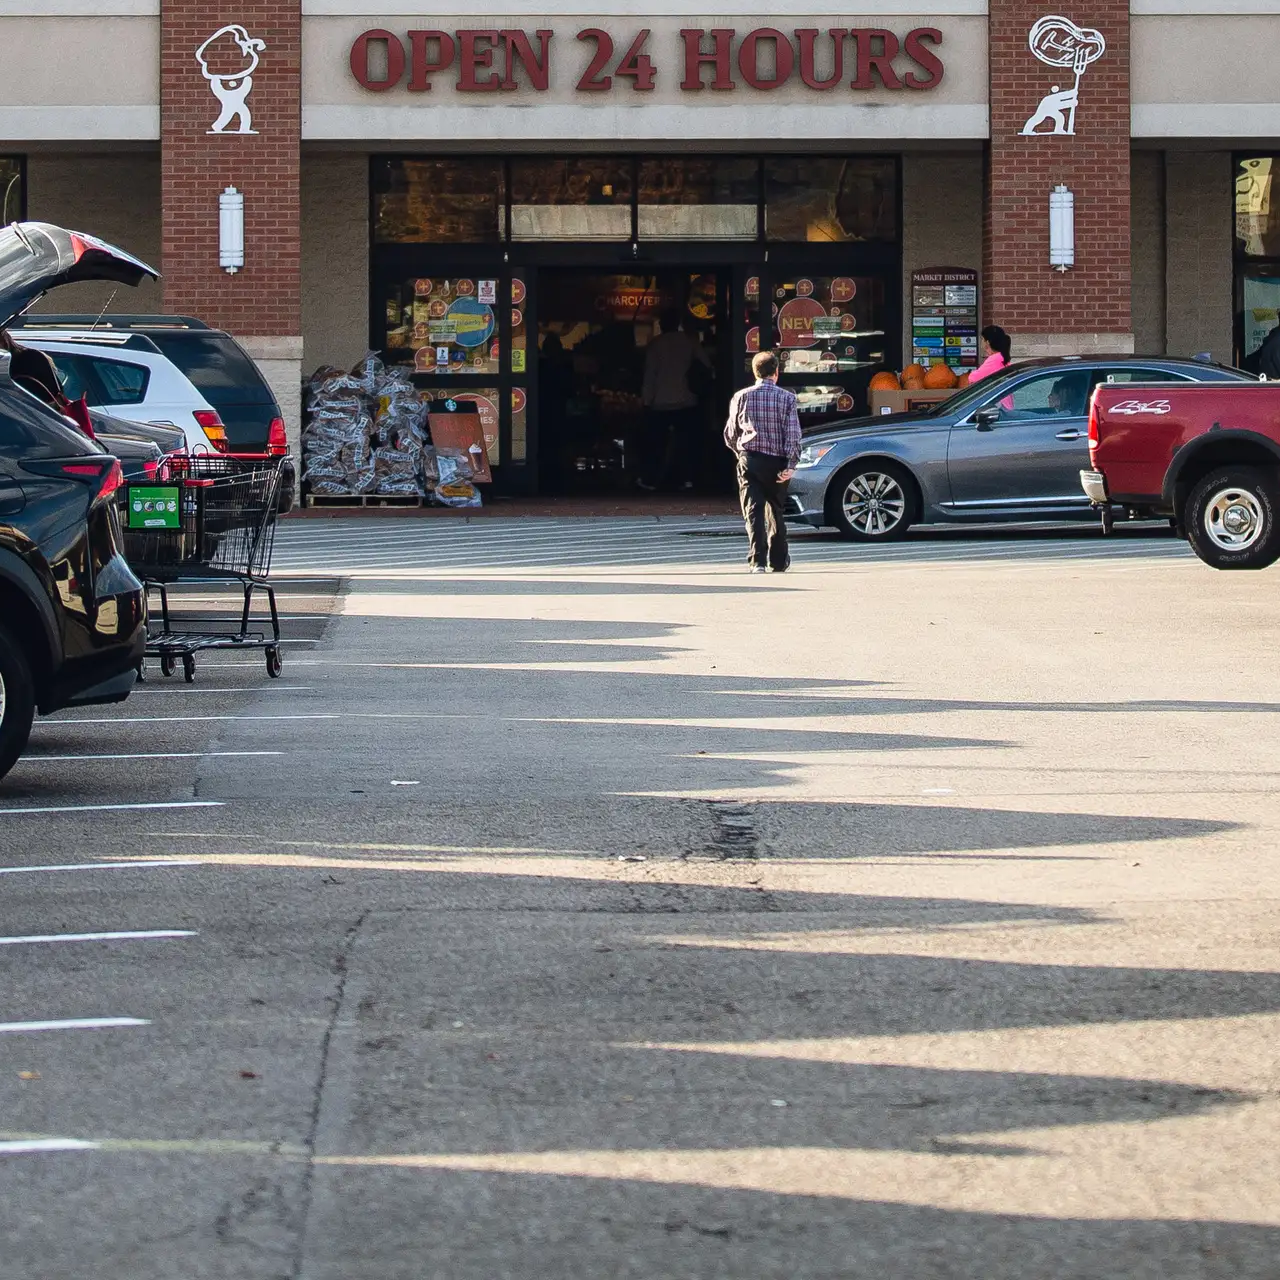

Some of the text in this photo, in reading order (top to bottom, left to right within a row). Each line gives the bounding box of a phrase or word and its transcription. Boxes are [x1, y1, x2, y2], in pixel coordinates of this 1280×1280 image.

[349, 26, 945, 92] OPEN 24 HOURS
[913, 273, 976, 281] MARKET DISTRICT
